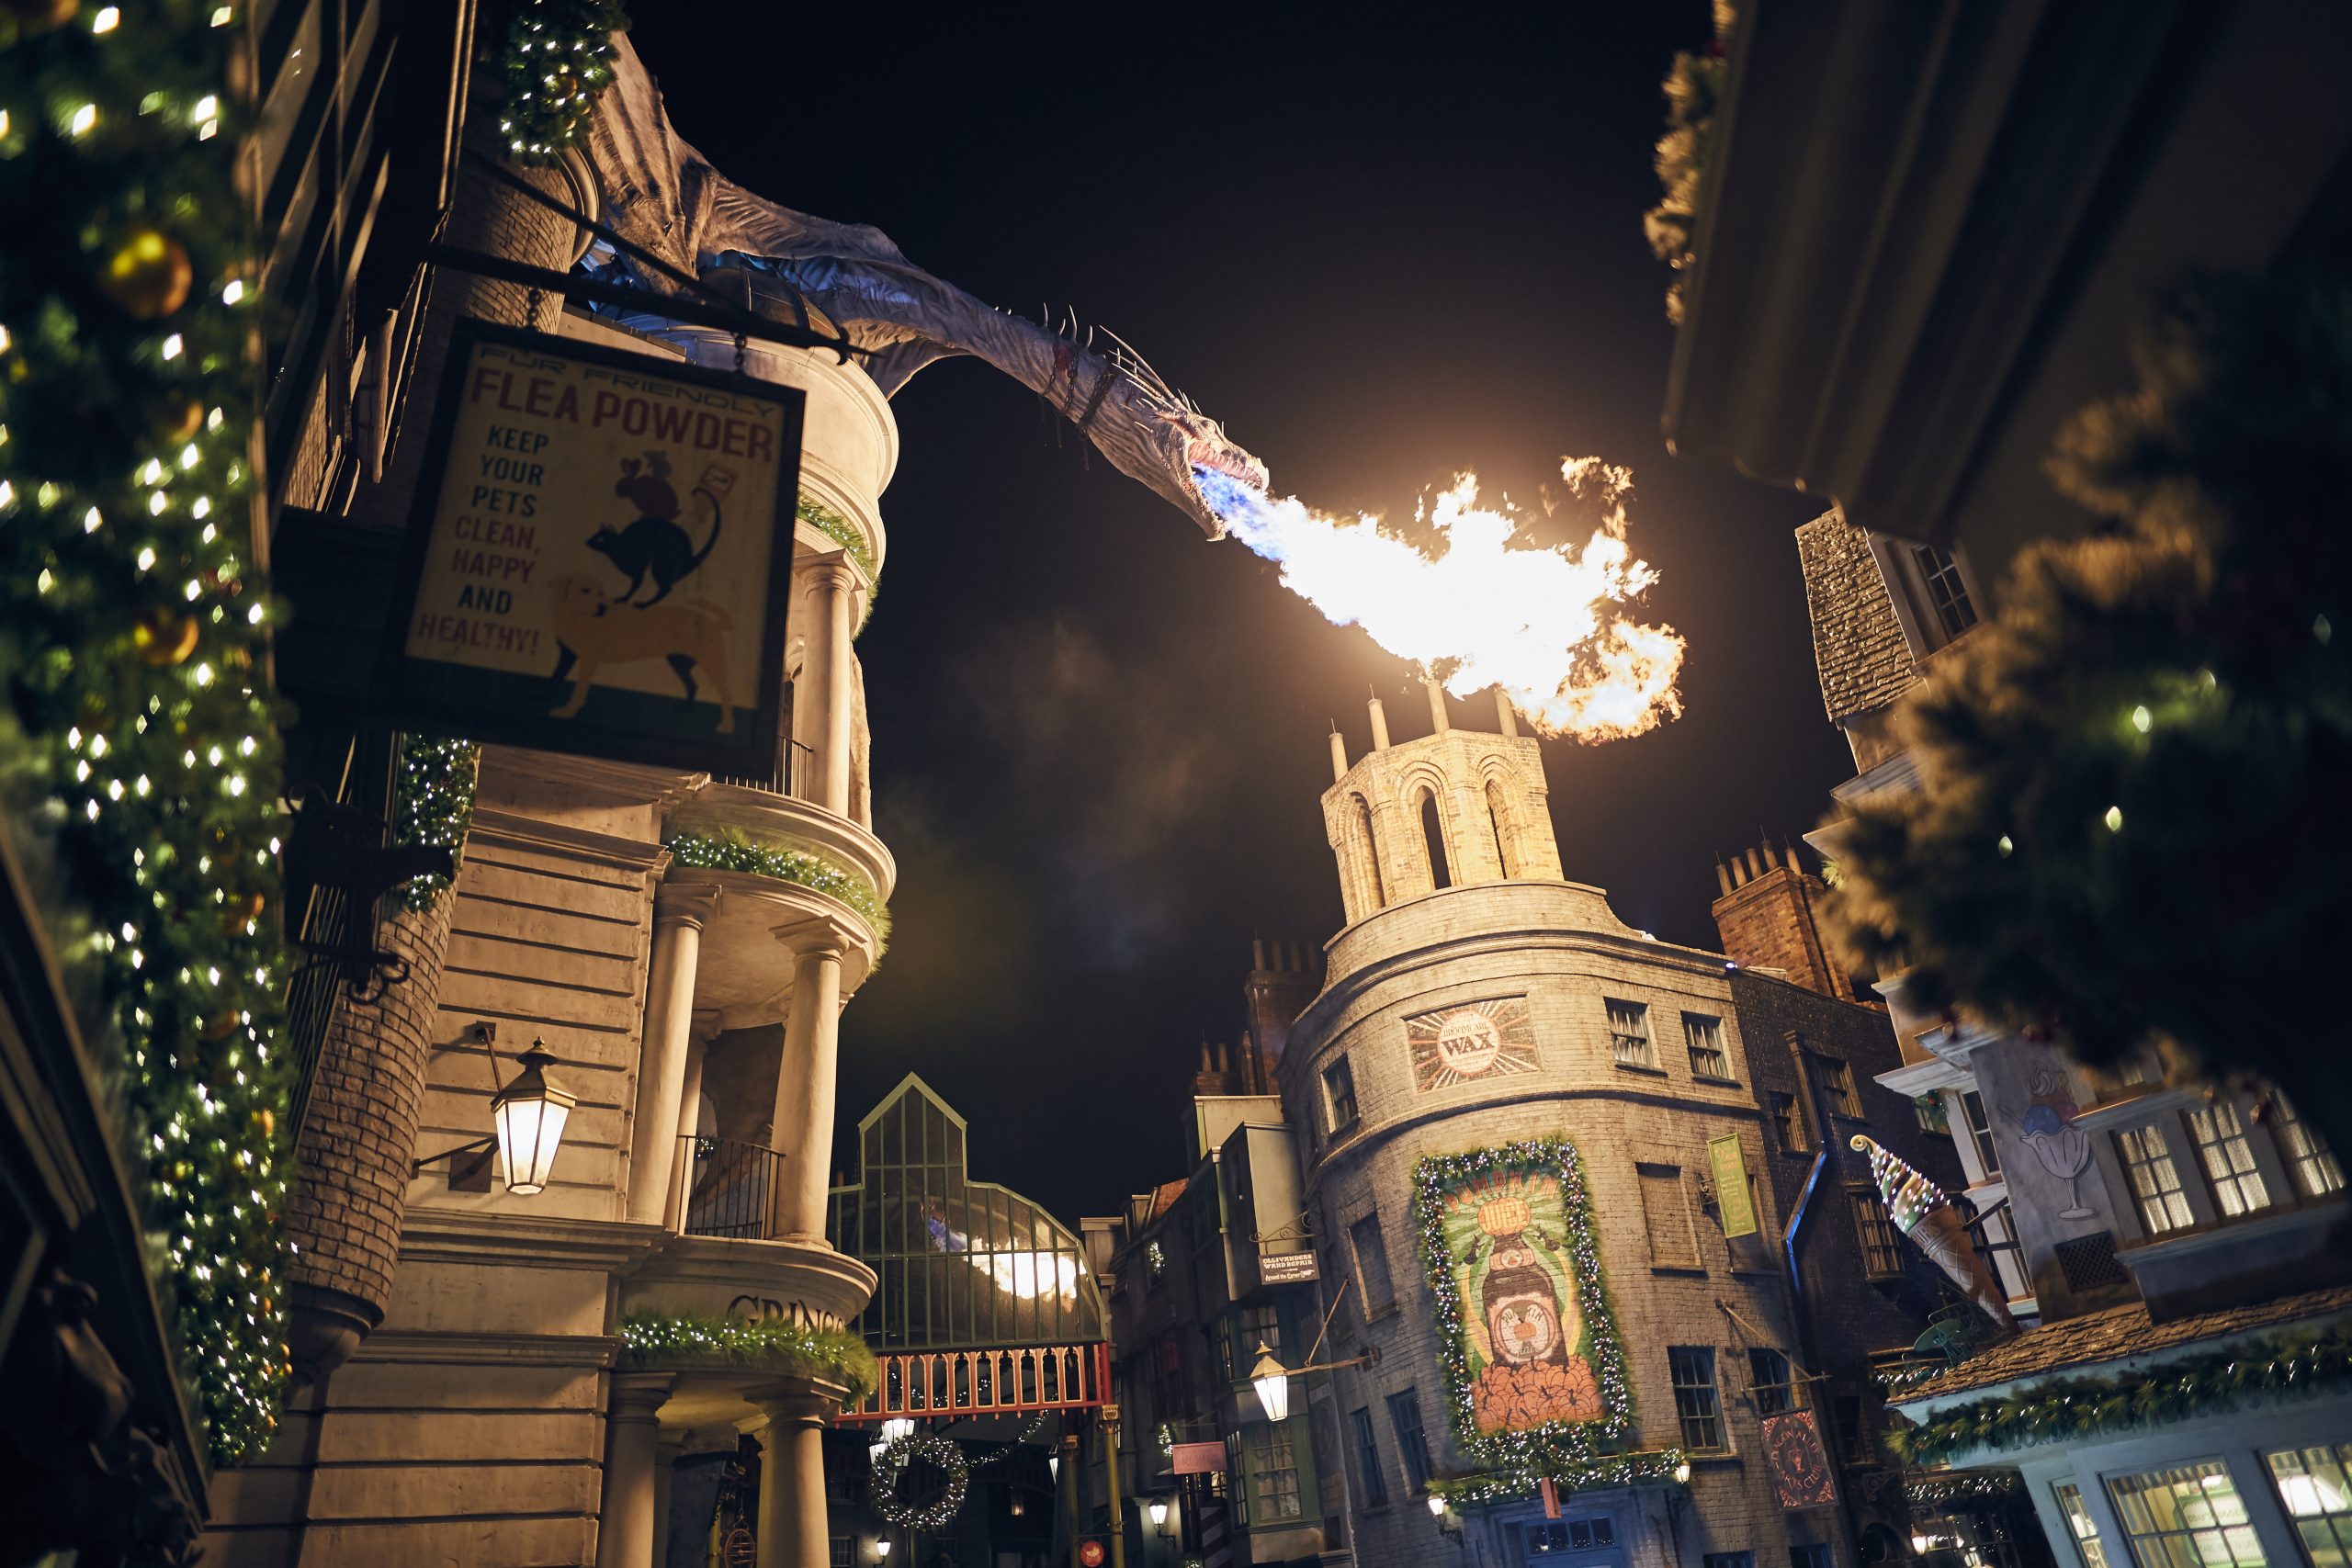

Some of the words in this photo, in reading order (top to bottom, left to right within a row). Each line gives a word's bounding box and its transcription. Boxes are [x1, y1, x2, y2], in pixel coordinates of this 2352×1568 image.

[481, 347, 566, 375] FUR
[583, 369, 776, 417] FRIENDLY
[470, 367, 578, 423] FLEA
[593, 390, 774, 463] POWDER
[487, 424, 549, 454] KEEP
[481, 454, 544, 487] YOUR
[471, 485, 537, 518] PETS
[454, 515, 540, 555] CLEAN,
[451, 547, 535, 583] HAPPY
[458, 584, 513, 615] AND
[418, 613, 540, 655] HEALTHY!
[1441, 1031, 1495, 1056] WAX
[1444, 1169, 1559, 1216] PUMPKIN
[1483, 1200, 1528, 1231] JUICE
[1262, 1254, 1312, 1264] OLLIVANDERS
[1263, 1261, 1286, 1269] WAND
[1286, 1259, 1313, 1268] REPAIR
[1804, 1463, 1822, 1489] CLUB
